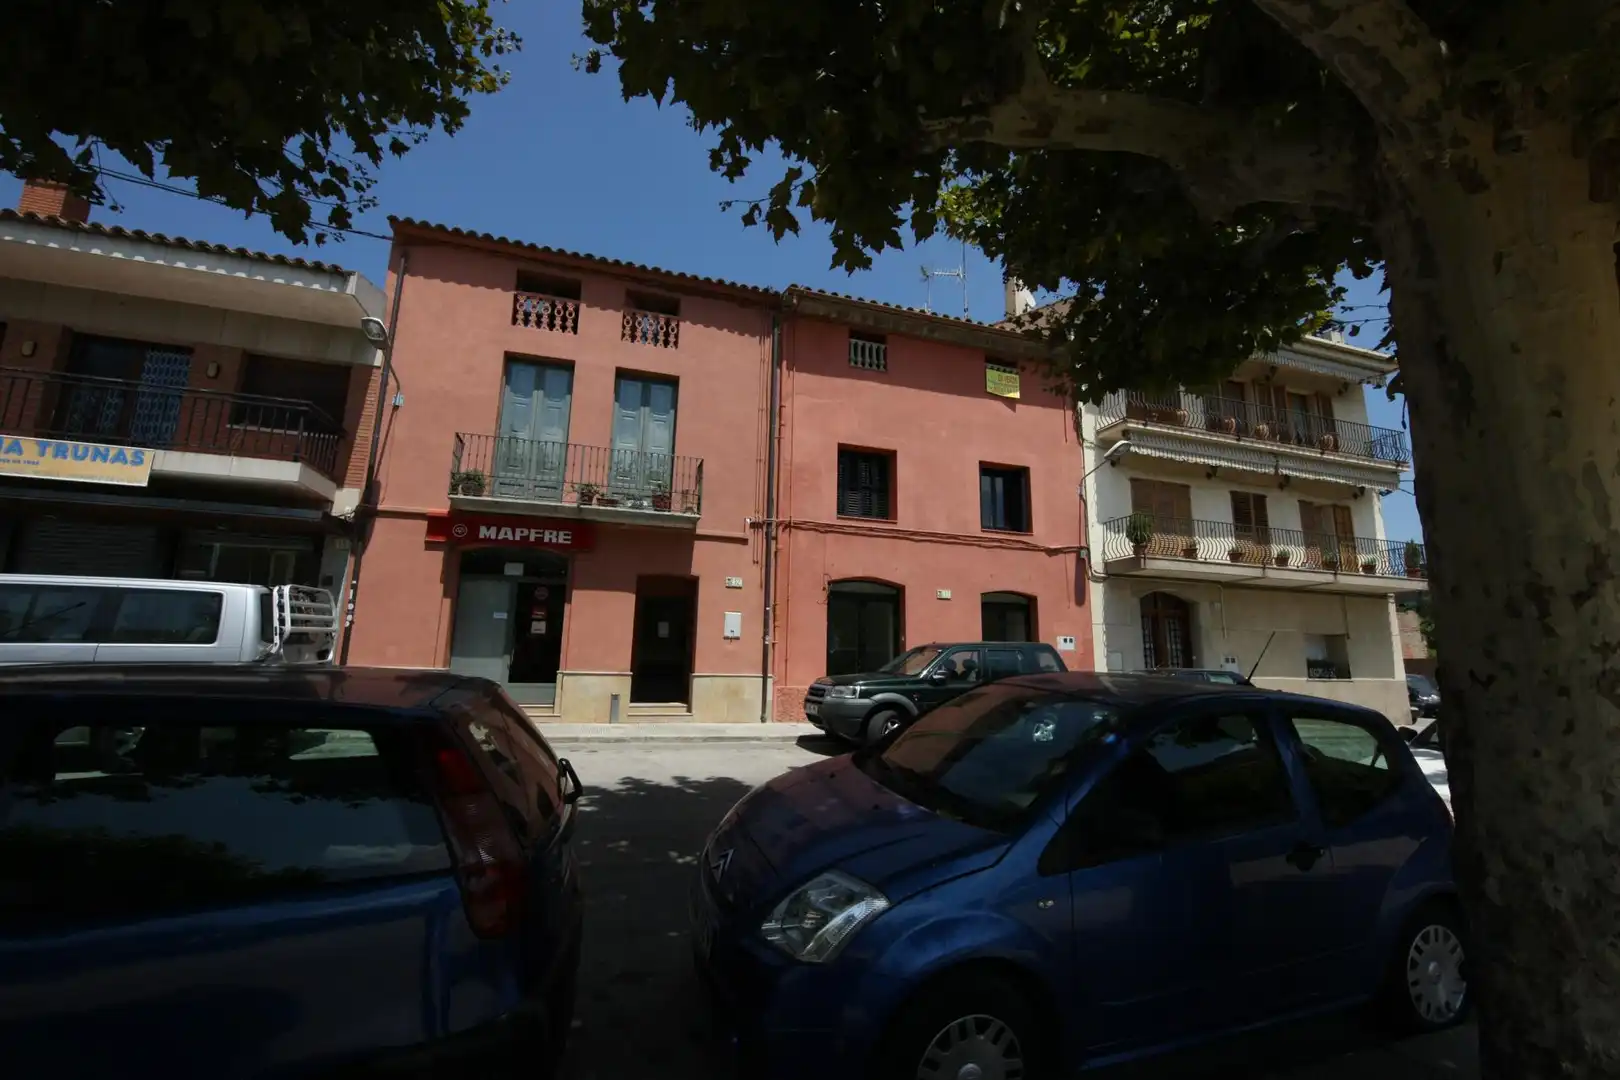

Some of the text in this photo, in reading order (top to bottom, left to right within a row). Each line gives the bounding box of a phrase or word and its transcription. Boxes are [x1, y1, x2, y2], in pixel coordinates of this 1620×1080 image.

[0, 437, 144, 466] A TRUNAS
[478, 525, 572, 544] MAPFRE
